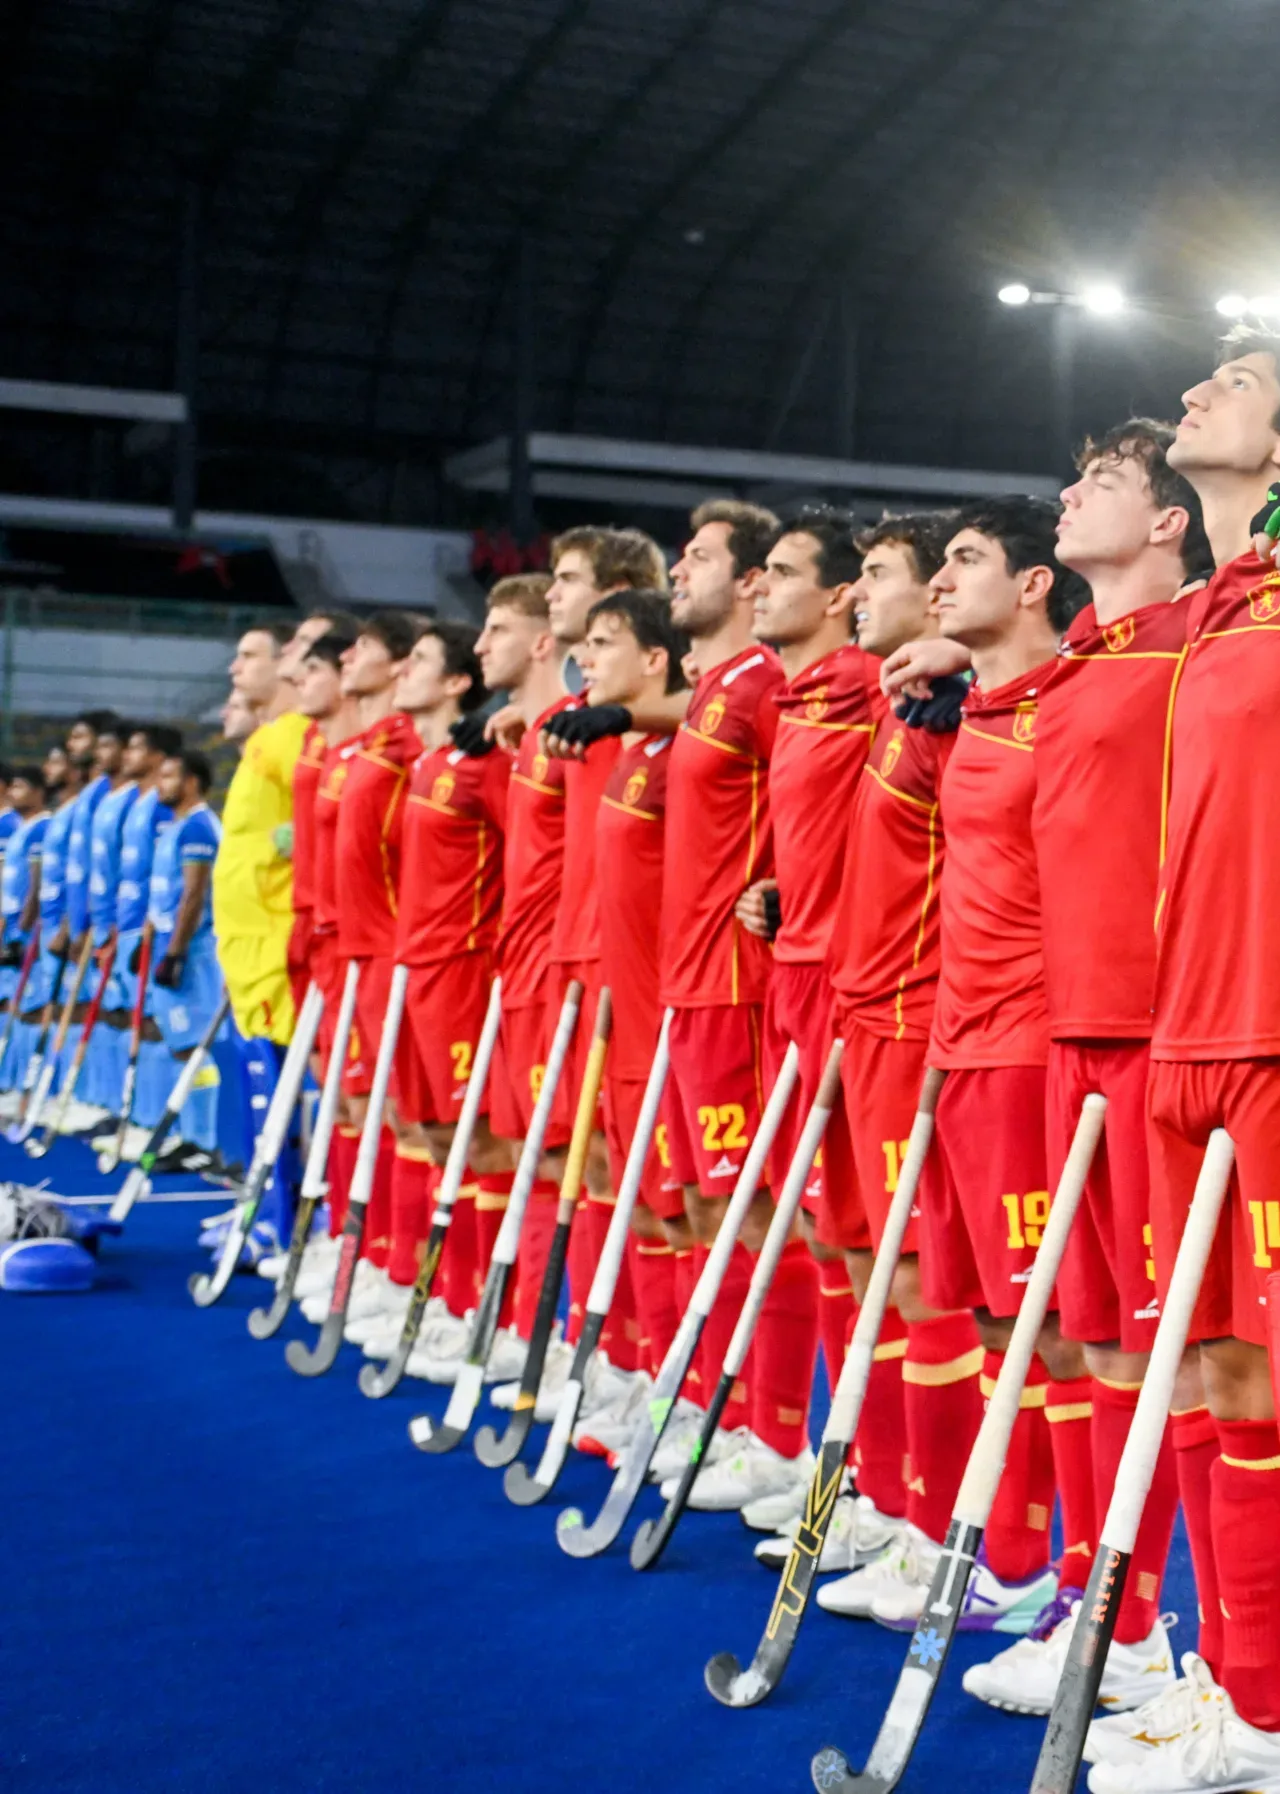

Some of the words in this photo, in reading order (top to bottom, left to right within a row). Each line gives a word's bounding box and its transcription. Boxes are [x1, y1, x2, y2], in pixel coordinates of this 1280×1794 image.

[450, 1040, 472, 1081] 2
[697, 1103, 749, 1151] 22
[1002, 1191, 1051, 1249] 19
[767, 1447, 845, 1640] TK
